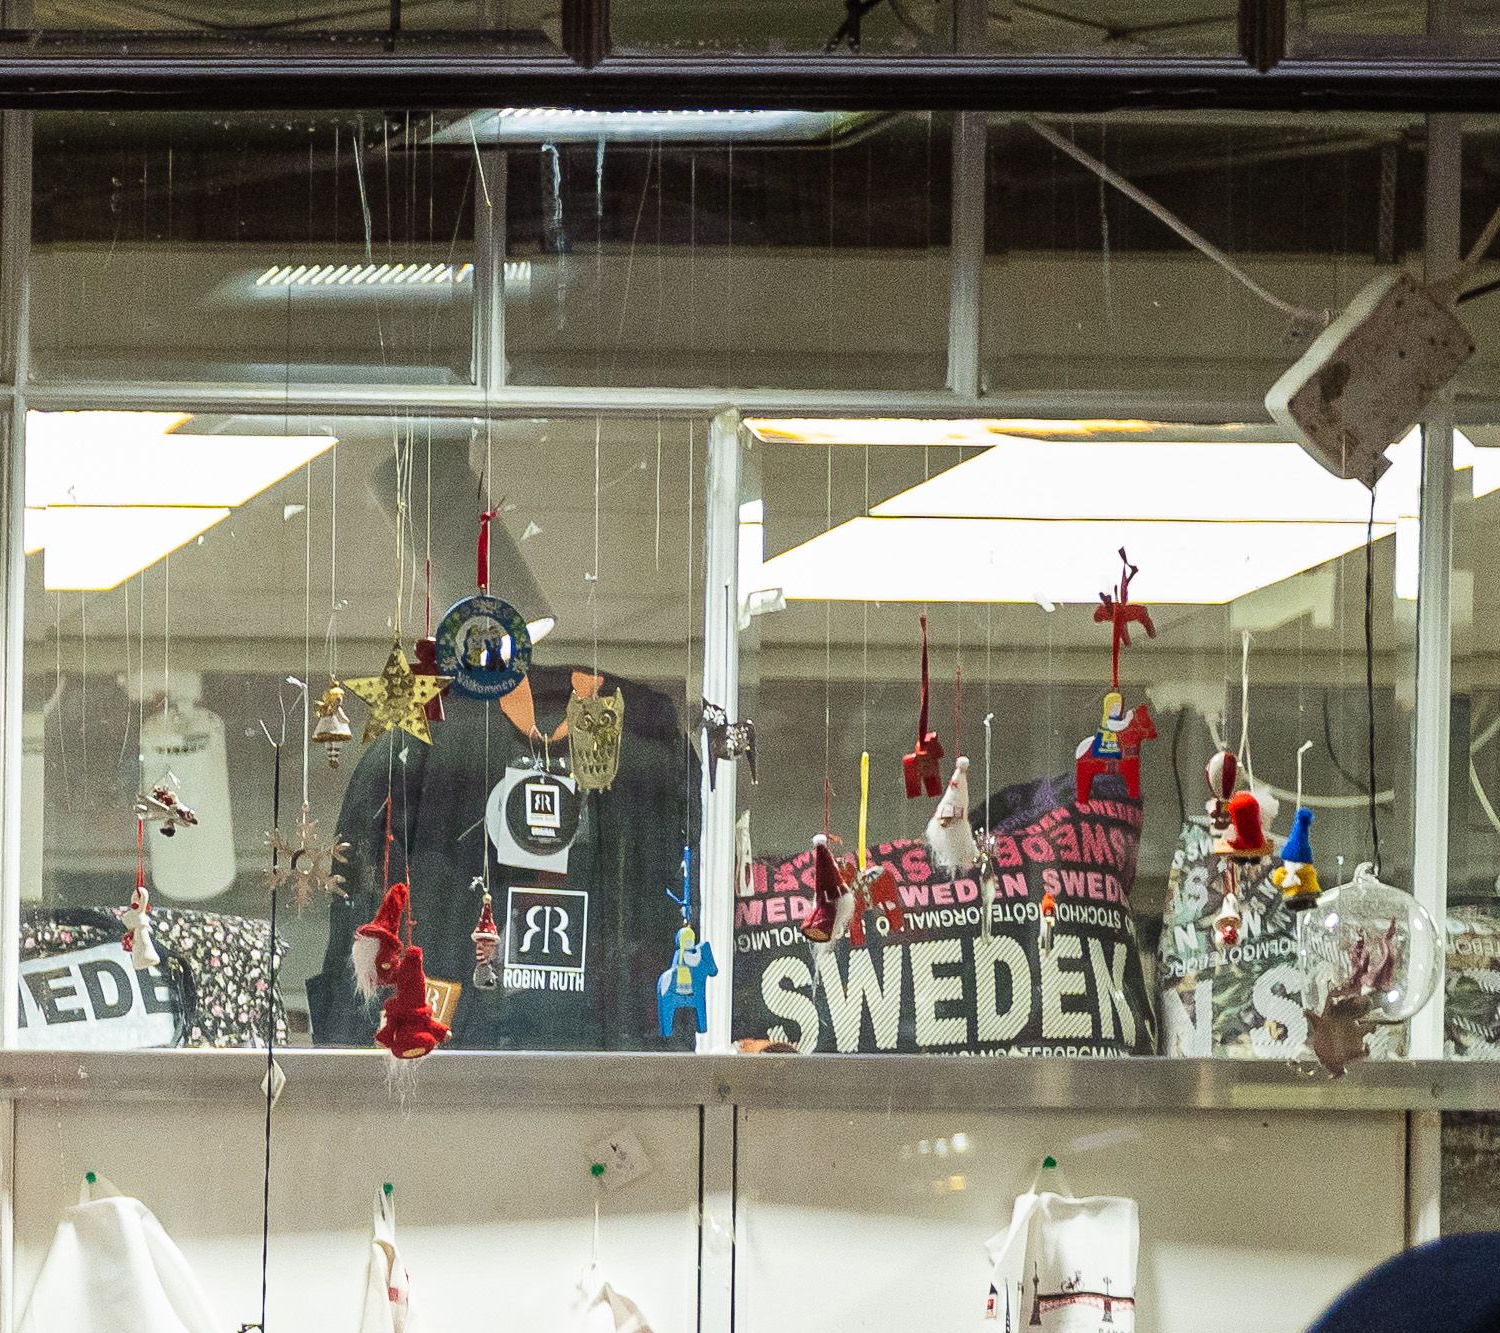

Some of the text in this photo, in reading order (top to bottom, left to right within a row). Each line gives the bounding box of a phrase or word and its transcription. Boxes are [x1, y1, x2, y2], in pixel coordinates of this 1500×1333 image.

[503, 968, 585, 992] ROBIN RUTH
[762, 935, 1137, 1056] SWEDEN
